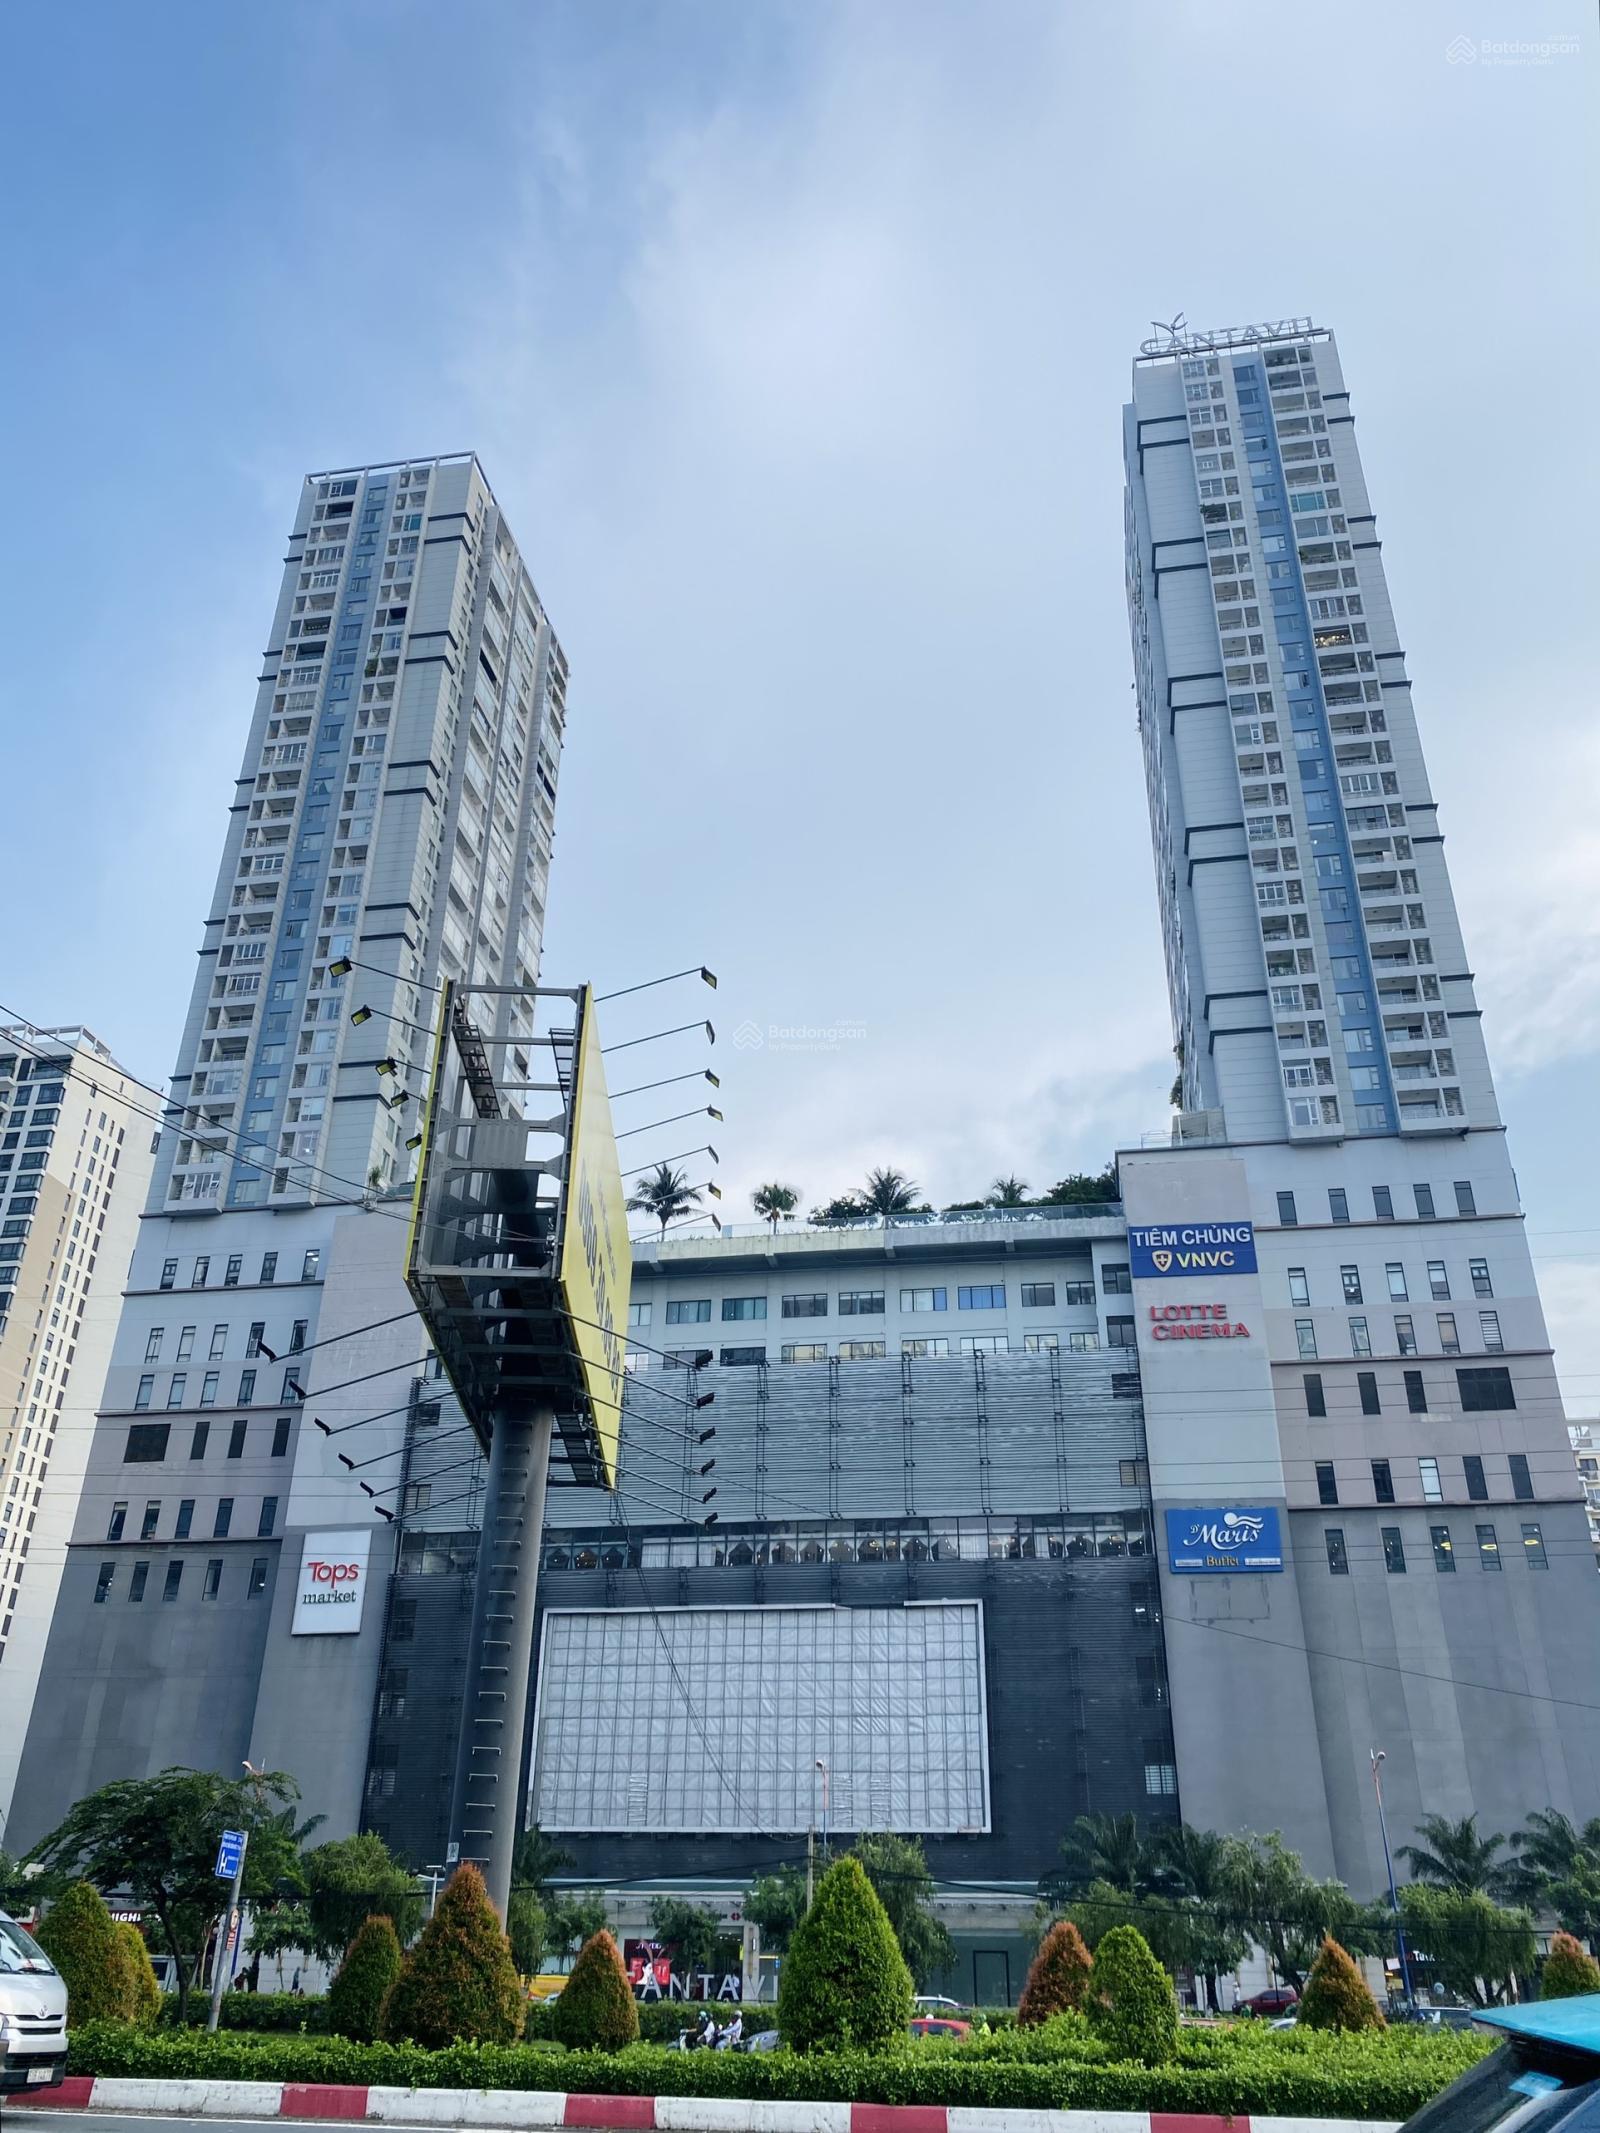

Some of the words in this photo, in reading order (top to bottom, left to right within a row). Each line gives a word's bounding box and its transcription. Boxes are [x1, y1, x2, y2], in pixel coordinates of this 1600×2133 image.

[1132, 1228, 1178, 1247] TIÊM
[1176, 1251, 1235, 1268] VNVC
[1150, 1304, 1227, 1321] LOTTE
[1152, 1322, 1250, 1340] CINEMA
[308, 1561, 360, 1589] Tops
[303, 1590, 357, 1605] market
